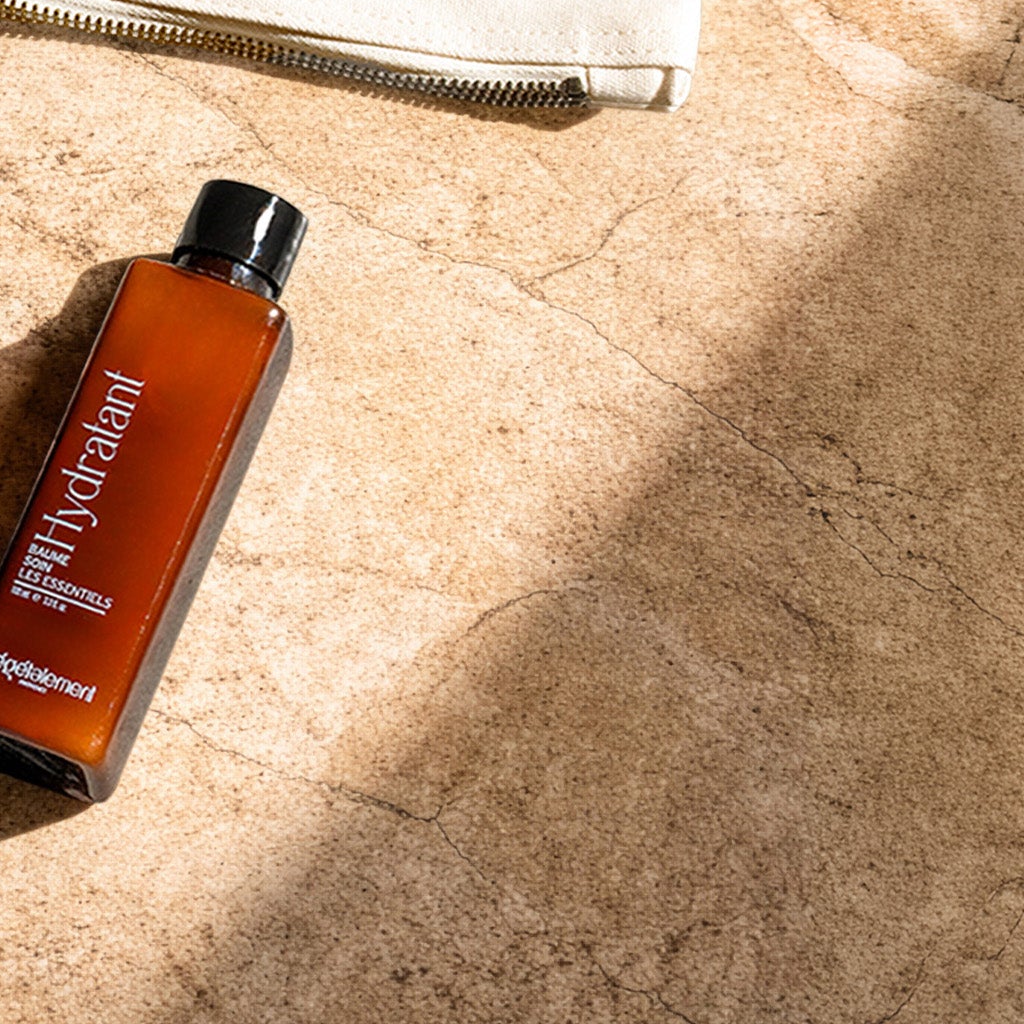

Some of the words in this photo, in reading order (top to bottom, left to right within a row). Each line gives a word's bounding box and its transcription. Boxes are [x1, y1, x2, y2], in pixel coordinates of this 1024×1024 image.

[34, 368, 145, 553] Hydratant
[22, 555, 54, 573] SOIN
[27, 542, 72, 567] BAUME
[18, 567, 42, 583] LES
[41, 576, 114, 610] ESSENTIELS
